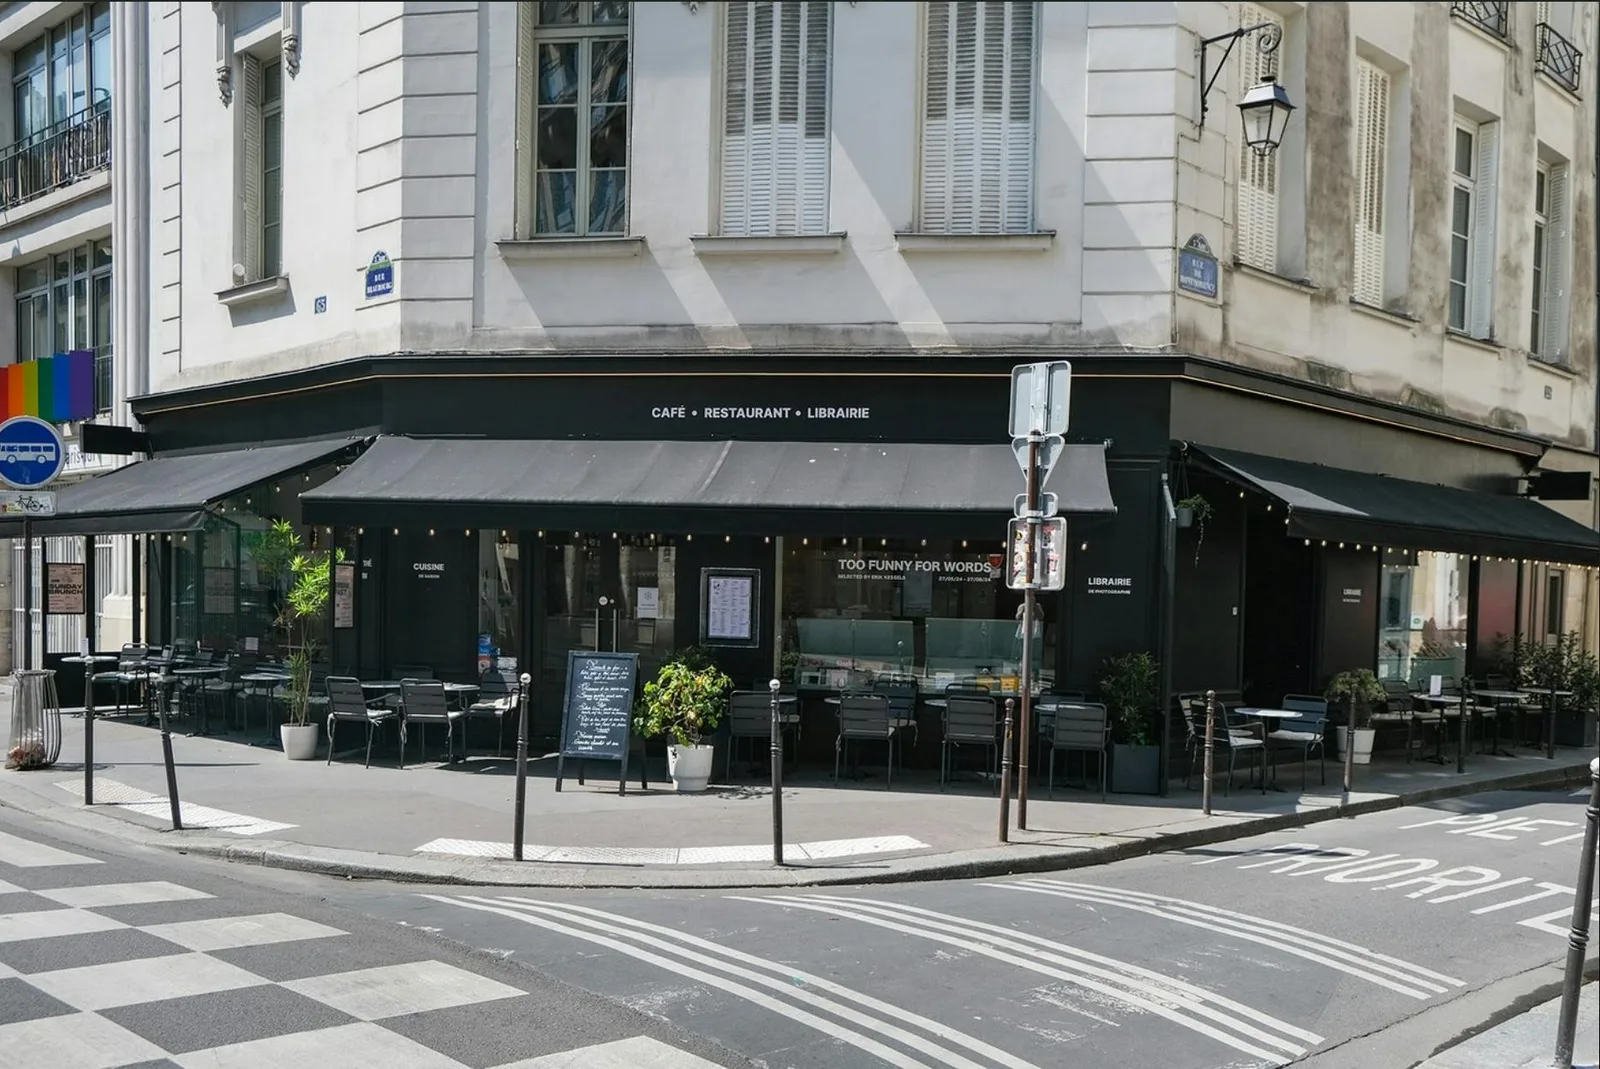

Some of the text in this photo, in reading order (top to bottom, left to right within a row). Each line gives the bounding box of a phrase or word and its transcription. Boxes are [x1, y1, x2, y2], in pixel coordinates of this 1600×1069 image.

[651, 405, 870, 419] CAFÉ RESTAURANT LIBRAIRIE
[412, 562, 445, 571] CUISINE
[838, 559, 992, 573] TOO FUNNY FOR WORDS
[1088, 577, 1132, 586] LIBRAIRIE
